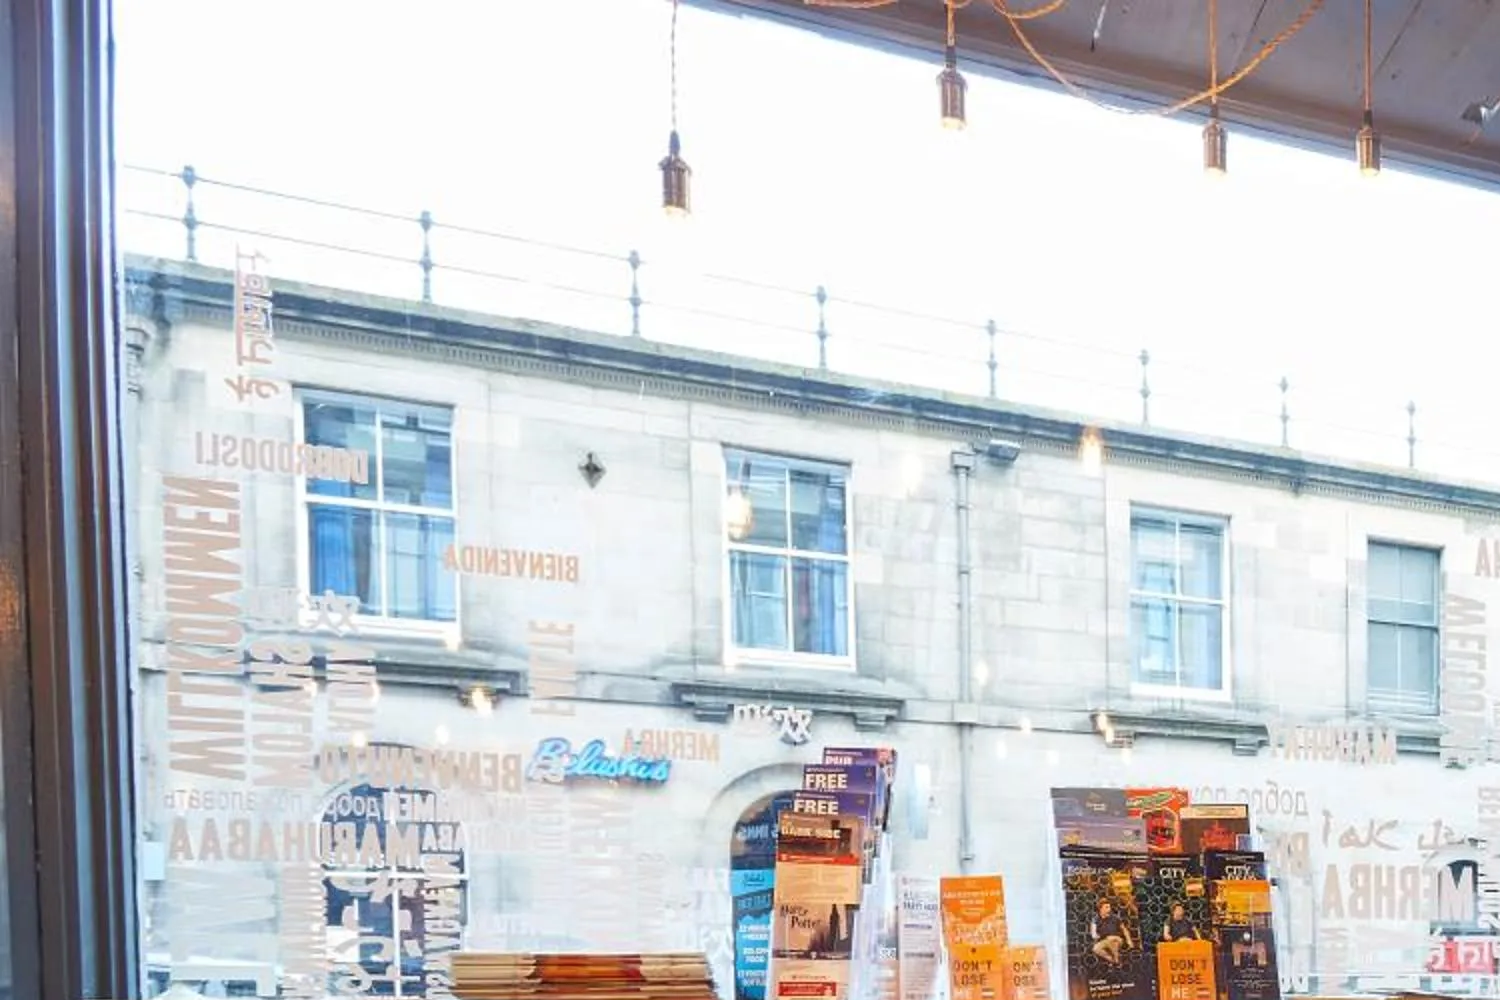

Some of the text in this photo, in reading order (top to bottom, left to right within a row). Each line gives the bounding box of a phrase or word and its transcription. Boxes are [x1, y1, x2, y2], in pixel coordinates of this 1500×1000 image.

[805, 773, 848, 789] FREE
[793, 799, 839, 815] FREE
[954, 959, 992, 971] DON'T
[1169, 958, 1208, 971] DON'T
[953, 973, 986, 986] LOSE
[1171, 973, 1202, 985] LOSE
[1170, 986, 1191, 999] ME
